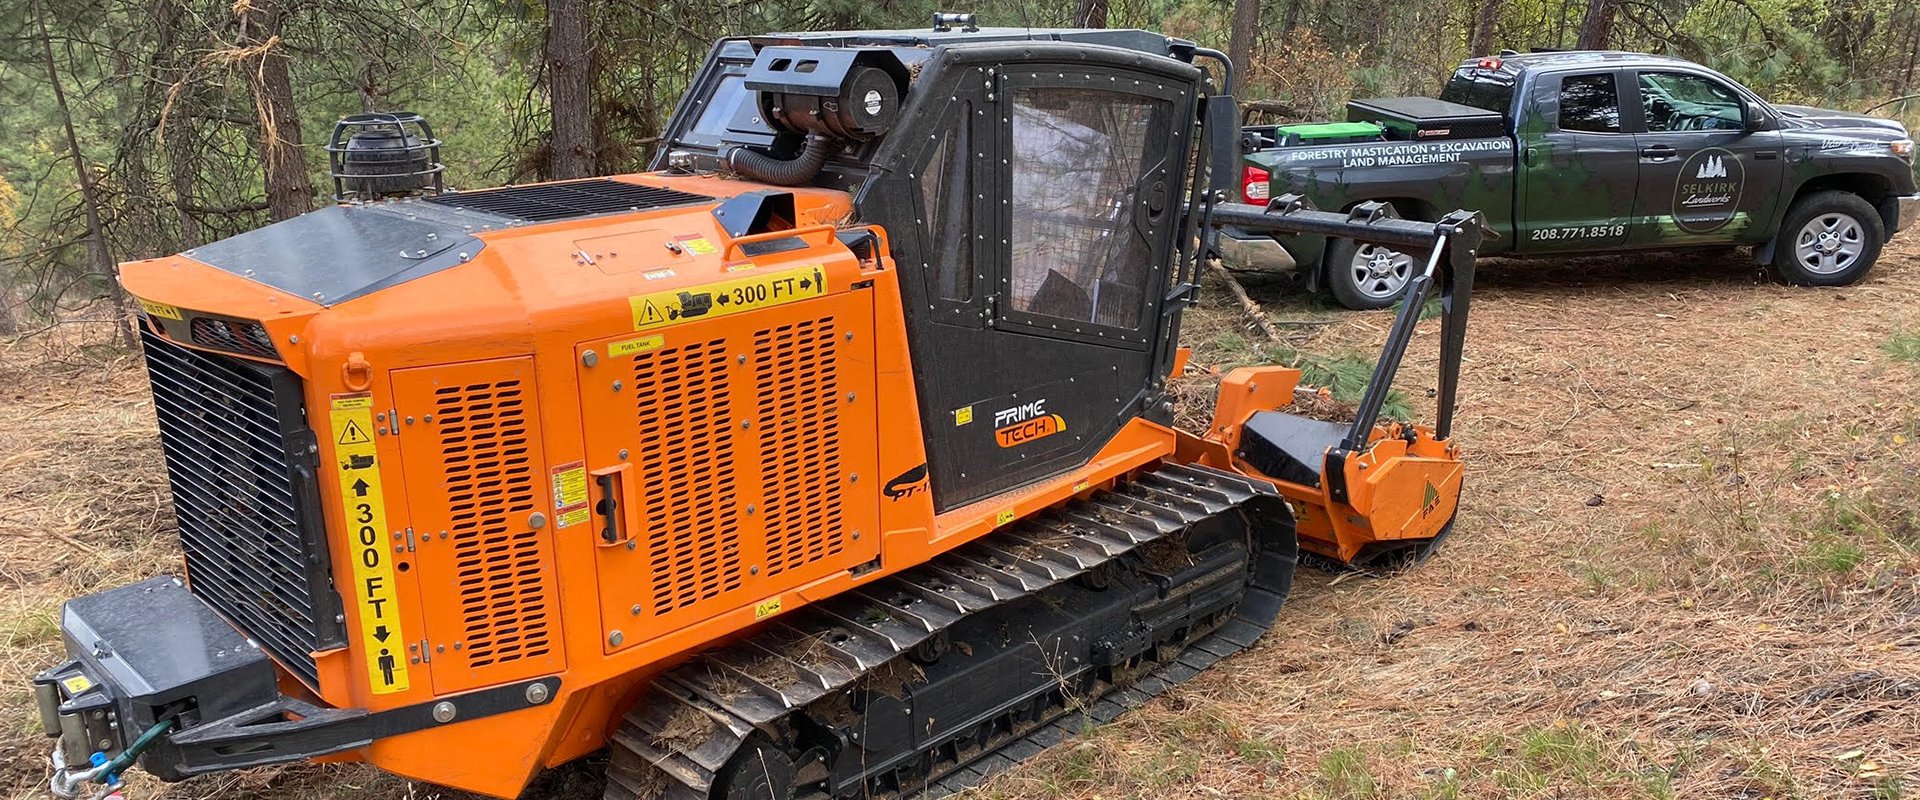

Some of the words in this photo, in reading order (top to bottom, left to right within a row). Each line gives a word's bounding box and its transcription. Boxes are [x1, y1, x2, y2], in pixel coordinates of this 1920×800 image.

[1291, 149, 1348, 161] FORESTRY
[1351, 145, 1428, 157] MASTICATION
[1439, 140, 1511, 152] EXCAVATION
[1343, 158, 1374, 168] LAND
[1377, 152, 1461, 166] MANAGEMENT
[1681, 182, 1738, 195] SELKIRK
[1682, 193, 1731, 205] Landworks
[1531, 225, 1624, 240] 208.771.8518
[733, 284, 767, 306] 300
[772, 277, 795, 298] FT
[994, 398, 1046, 428] PRIME
[1000, 419, 1046, 445] TECH
[355, 503, 379, 568] 300
[366, 576, 387, 619] FT
